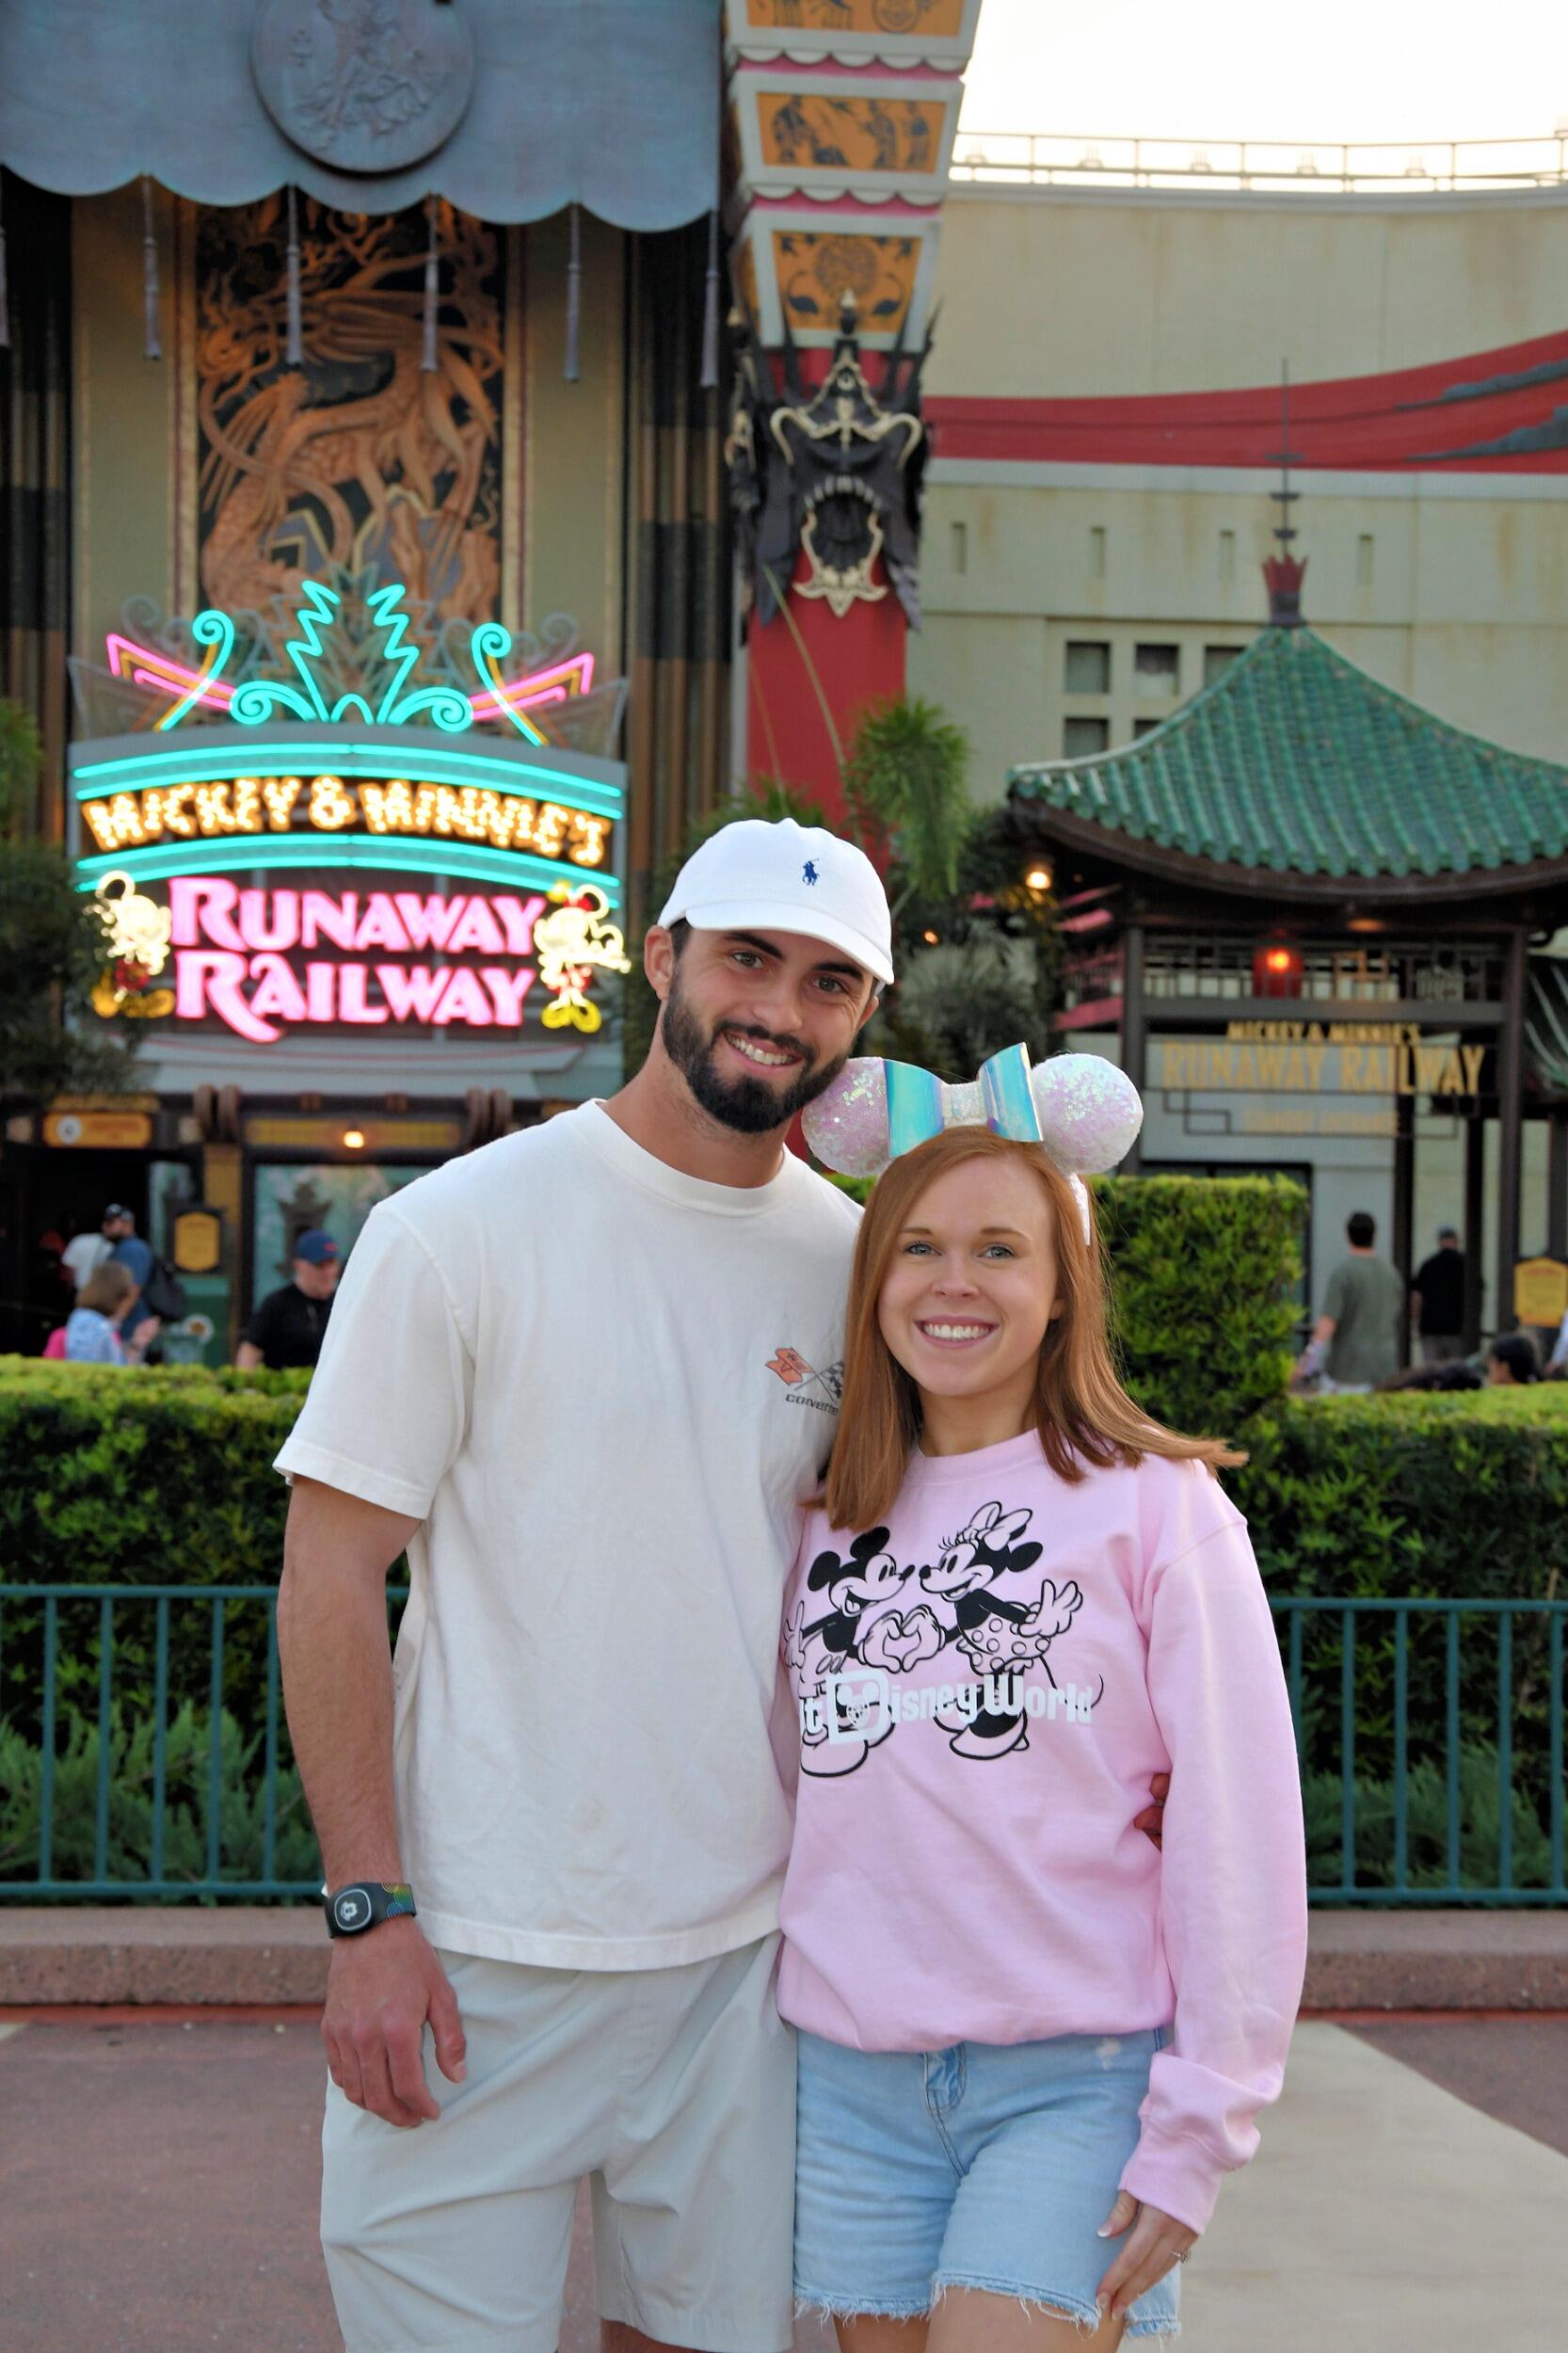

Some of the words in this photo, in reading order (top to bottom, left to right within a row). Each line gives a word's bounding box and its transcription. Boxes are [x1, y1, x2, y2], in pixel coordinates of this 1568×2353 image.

[83, 777, 300, 850] MICKEY
[309, 775, 355, 829] &
[169, 875, 547, 954] RUNAWAY
[174, 950, 536, 1042] RAILWAY
[1163, 1042, 1324, 1091] RUNAWAY
[1340, 1044, 1484, 1095] RAILWAY
[826, 1669, 978, 1746] Disney
[983, 1673, 1094, 1724] World
